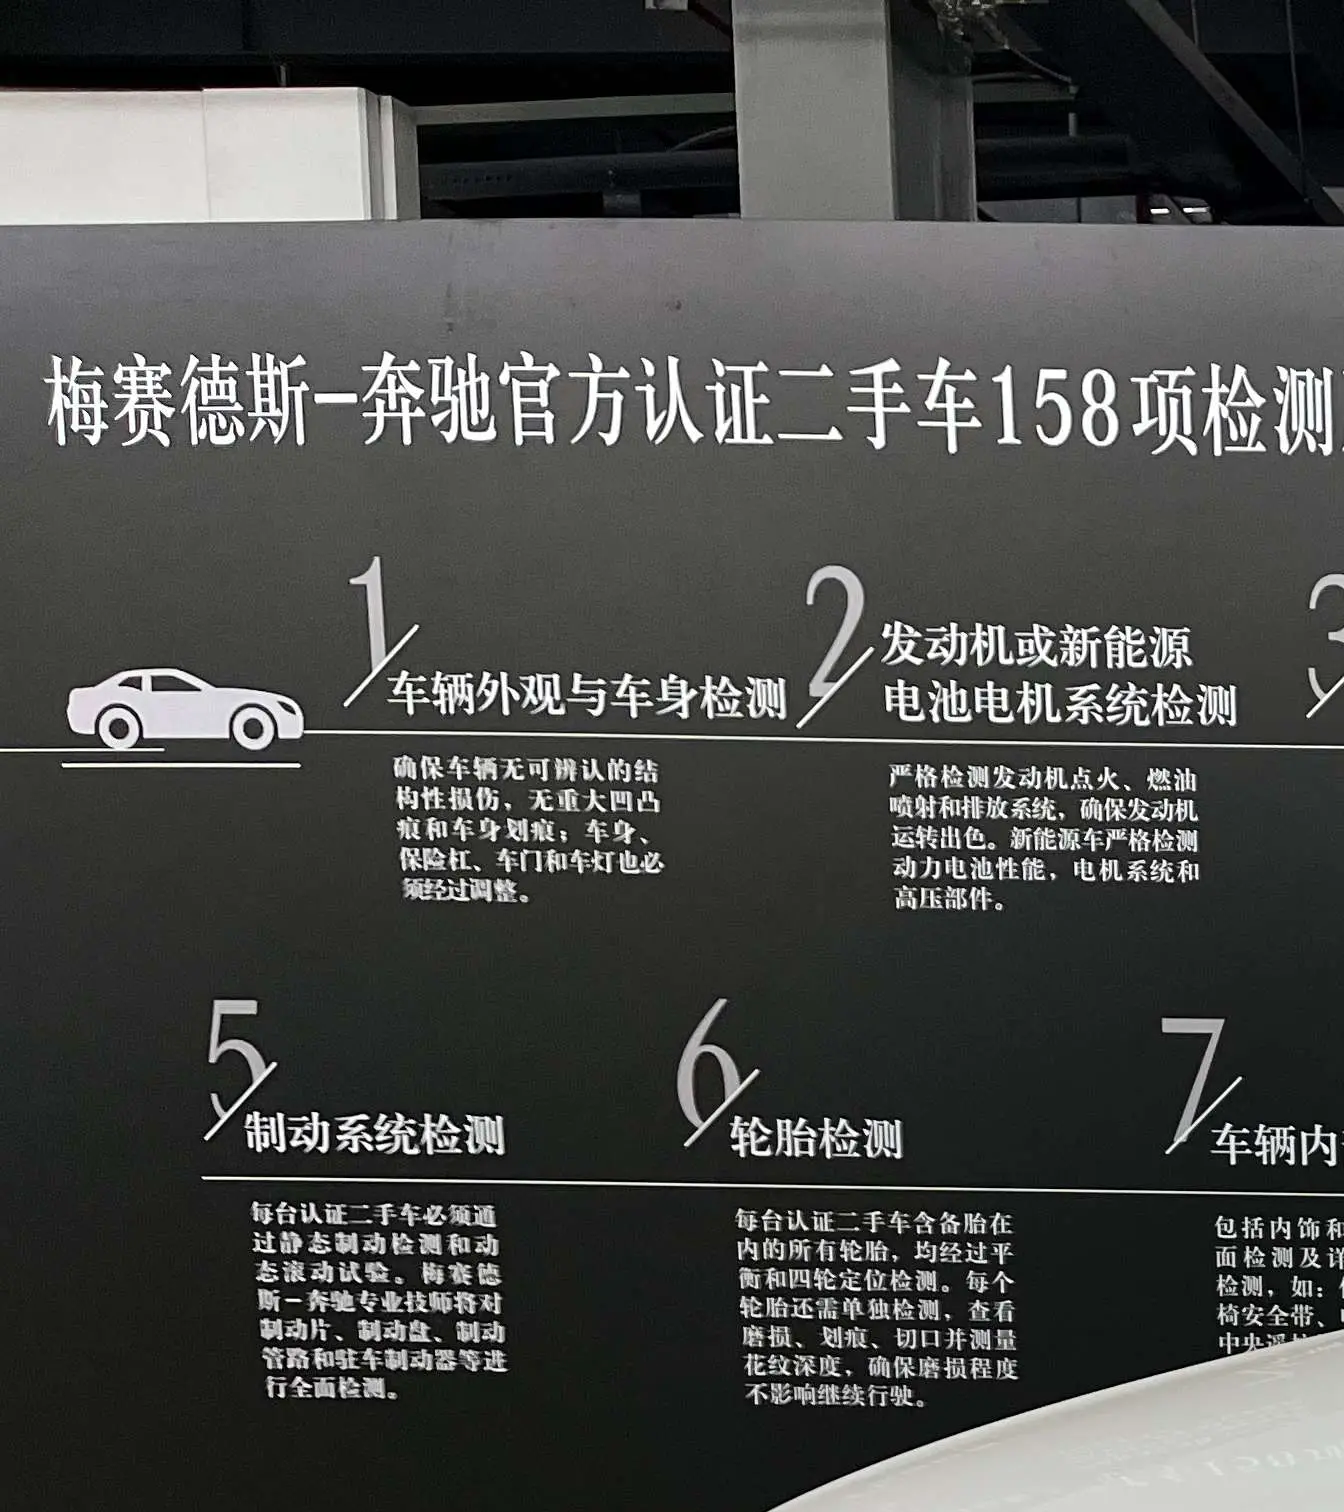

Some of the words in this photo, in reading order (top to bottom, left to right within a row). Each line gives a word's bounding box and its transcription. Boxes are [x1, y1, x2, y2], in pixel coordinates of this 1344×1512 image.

[880, 620, 1193, 669] 发动机或新能源
[387, 669, 787, 720] 车辆外观与车身检测
[884, 678, 1237, 727] 电池电机系统检测
[243, 1110, 505, 1156] 制动系统检测
[729, 1115, 903, 1160] 轮胎检测
[1219, 1331, 1308, 1356] 中央遥
